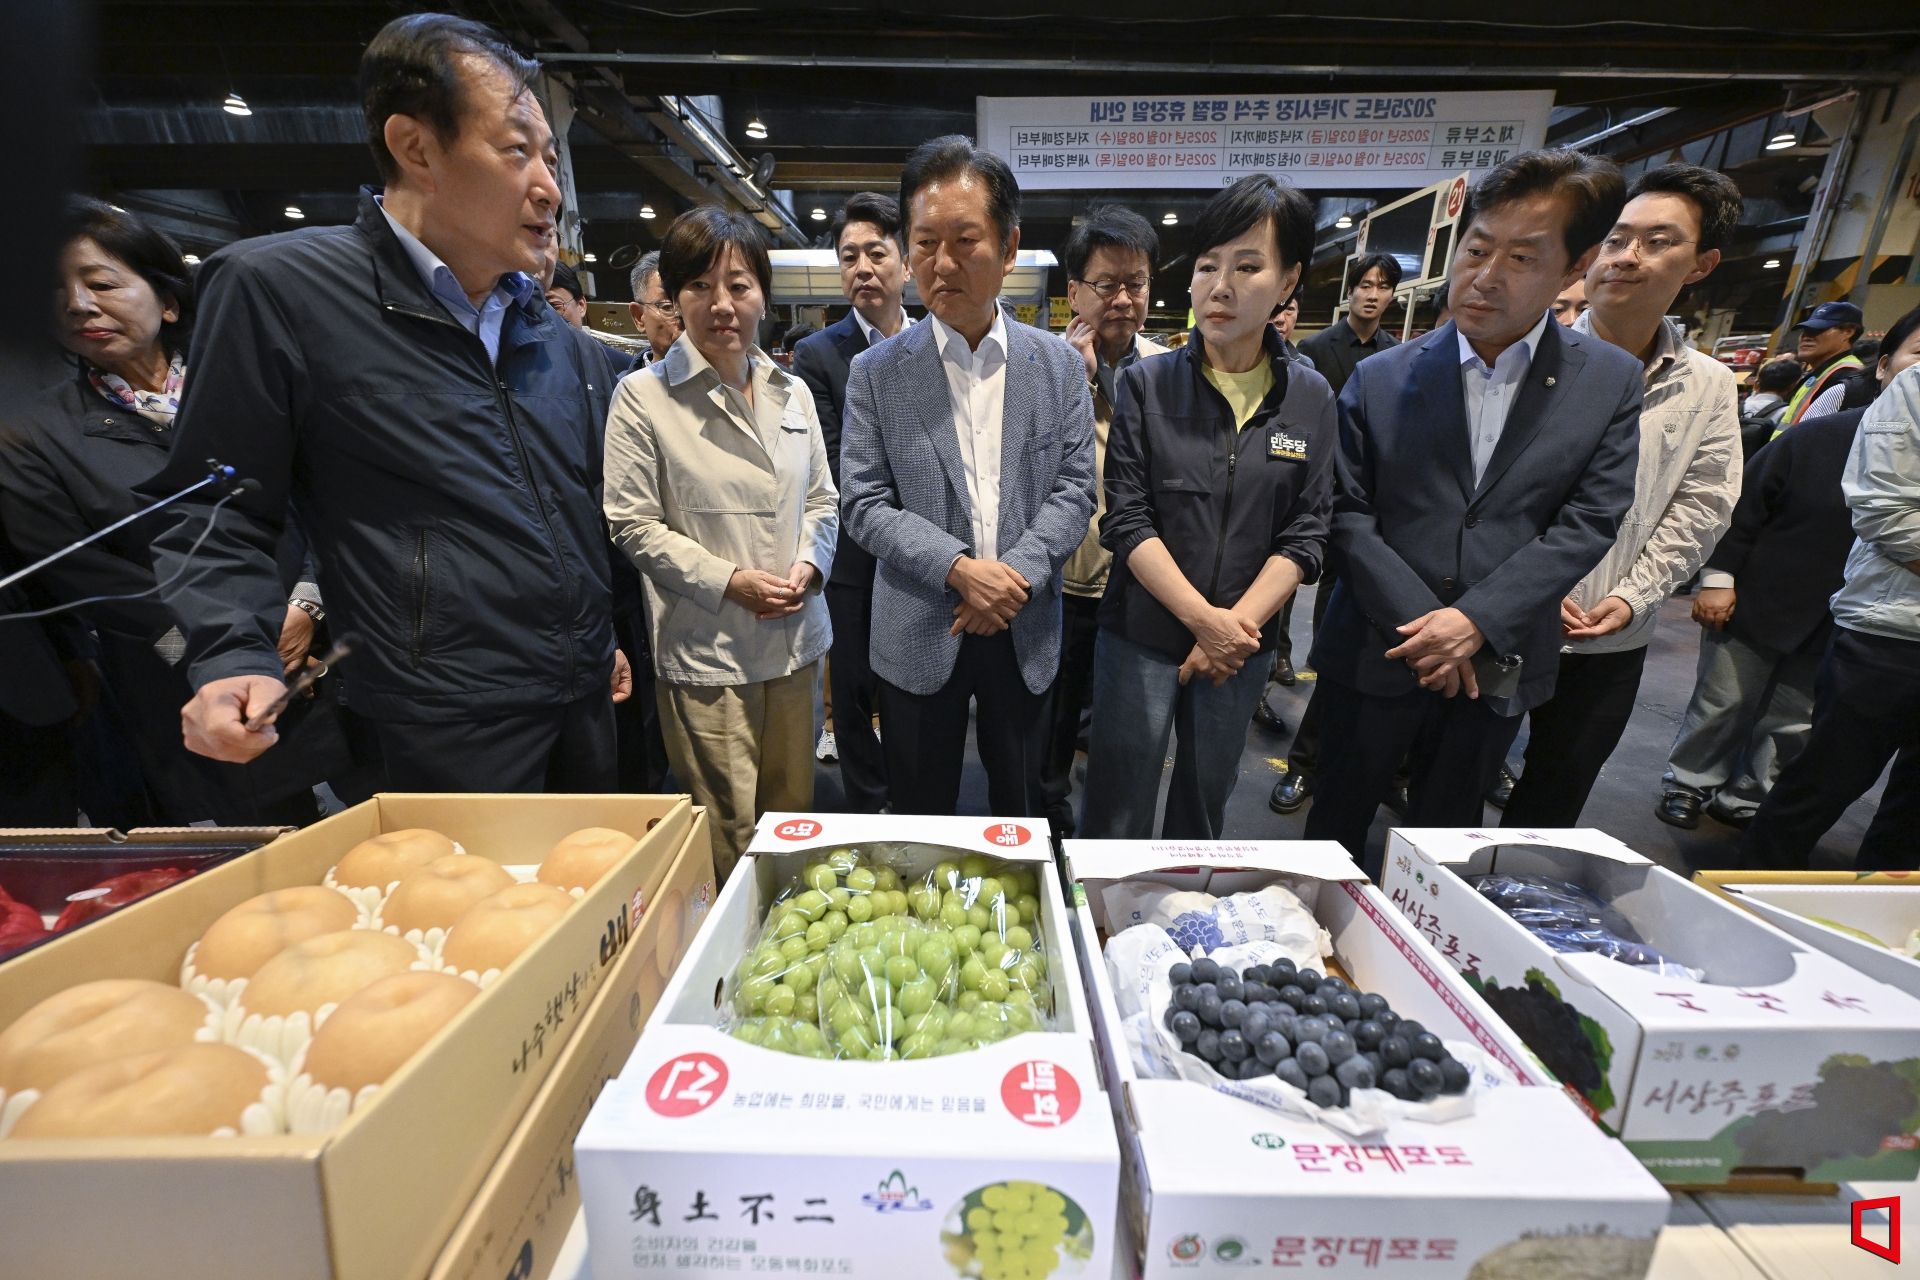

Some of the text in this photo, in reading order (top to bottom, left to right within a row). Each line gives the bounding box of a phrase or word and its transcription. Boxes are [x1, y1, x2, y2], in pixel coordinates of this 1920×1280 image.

[1449, 183, 1464, 210] 21
[1270, 436, 1307, 452] 민주당
[598, 903, 629, 968] 배
[1291, 1143, 1474, 1175] 문장대포도
[630, 1184, 835, 1228] 身土不二
[1270, 1235, 1458, 1269] 문장대포도
